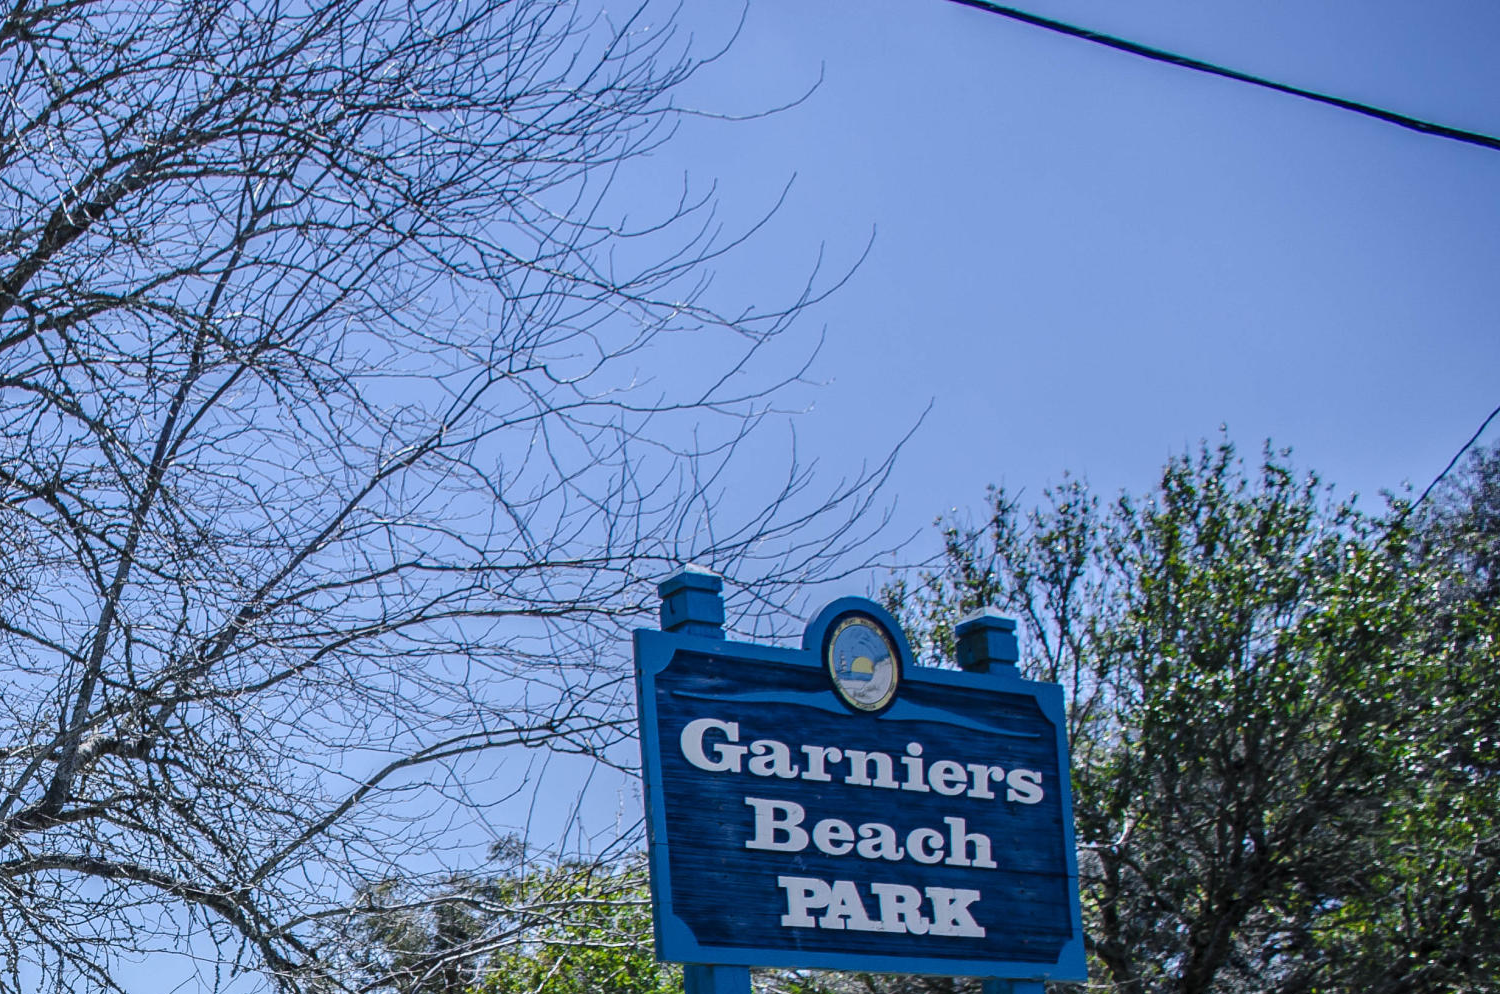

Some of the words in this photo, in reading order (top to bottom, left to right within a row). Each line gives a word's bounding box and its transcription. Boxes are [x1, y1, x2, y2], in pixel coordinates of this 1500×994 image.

[680, 718, 1044, 804] Garniers
[745, 797, 997, 869] Beach
[778, 875, 986, 938] PARK
